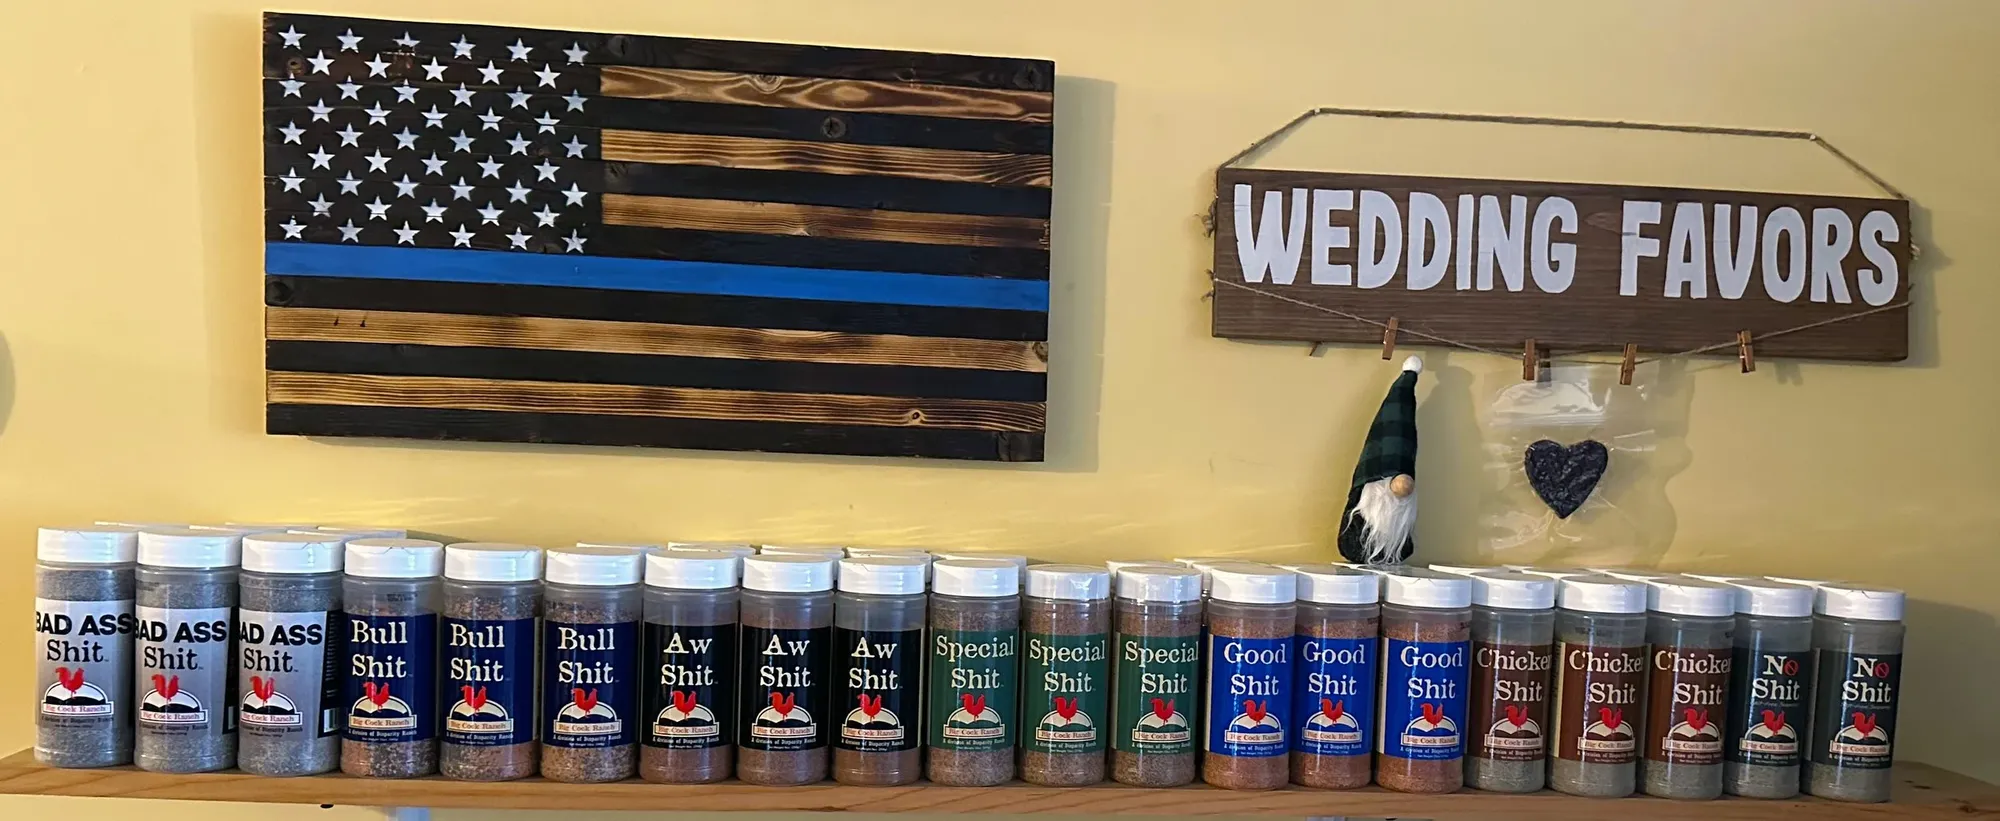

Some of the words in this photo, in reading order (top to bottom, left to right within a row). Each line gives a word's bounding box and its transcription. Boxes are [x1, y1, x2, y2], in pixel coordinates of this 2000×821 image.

[1234, 184, 1578, 294] WEDDING
[1619, 200, 1899, 306] FAVORS
[79, 613, 133, 635] ASS
[173, 621, 227, 643] ASS
[270, 624, 322, 646] ASS
[351, 620, 407, 644] Bull
[450, 624, 505, 648] Bull
[558, 627, 615, 650] Bull
[664, 632, 712, 654] Aw
[762, 634, 810, 656] Aw
[47, 639, 104, 663] Shit
[144, 646, 198, 670] Shit
[851, 637, 897, 659] Aw
[937, 635, 1014, 662] Special
[1029, 639, 1105, 666] Special
[1125, 641, 1199, 667] Special
[1224, 642, 1286, 665] Good
[1303, 641, 1365, 665] Good
[1401, 646, 1463, 669] Good
[244, 648, 293, 672] Shit
[352, 654, 406, 678] Shit
[451, 657, 504, 682] Shit
[1569, 650, 1643, 673] Chicke
[559, 661, 614, 684] Shit
[661, 664, 713, 686] Shit
[760, 666, 811, 687] Shit
[849, 668, 898, 690] Shit
[951, 668, 1000, 689] Shit
[1044, 671, 1092, 693] Shit
[1141, 673, 1187, 693] Shit
[1231, 674, 1279, 696] Shit
[1308, 673, 1357, 696] Shit
[1408, 677, 1455, 699] Shit
[1496, 680, 1542, 702] Shit
[1589, 682, 1635, 704] Shit
[1674, 683, 1722, 705] Shit
[1752, 677, 1800, 700] Shit
[1842, 680, 1891, 703] Shit
